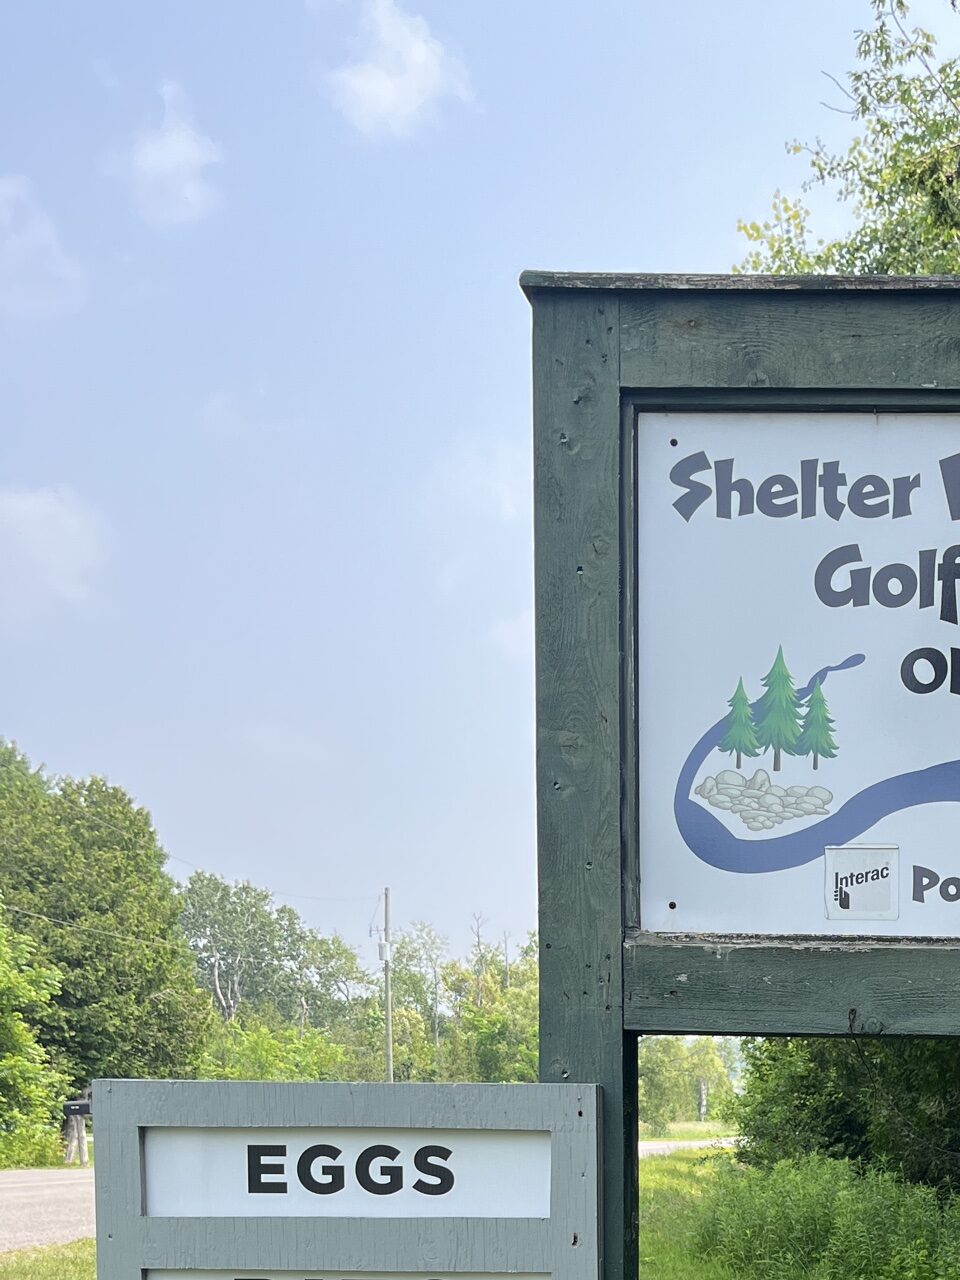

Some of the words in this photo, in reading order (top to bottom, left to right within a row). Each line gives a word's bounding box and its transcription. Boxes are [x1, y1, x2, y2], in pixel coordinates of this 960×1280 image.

[670, 452, 920, 522] Shelter
[834, 866, 889, 889] Interac
[248, 1144, 454, 1195] EGGS
